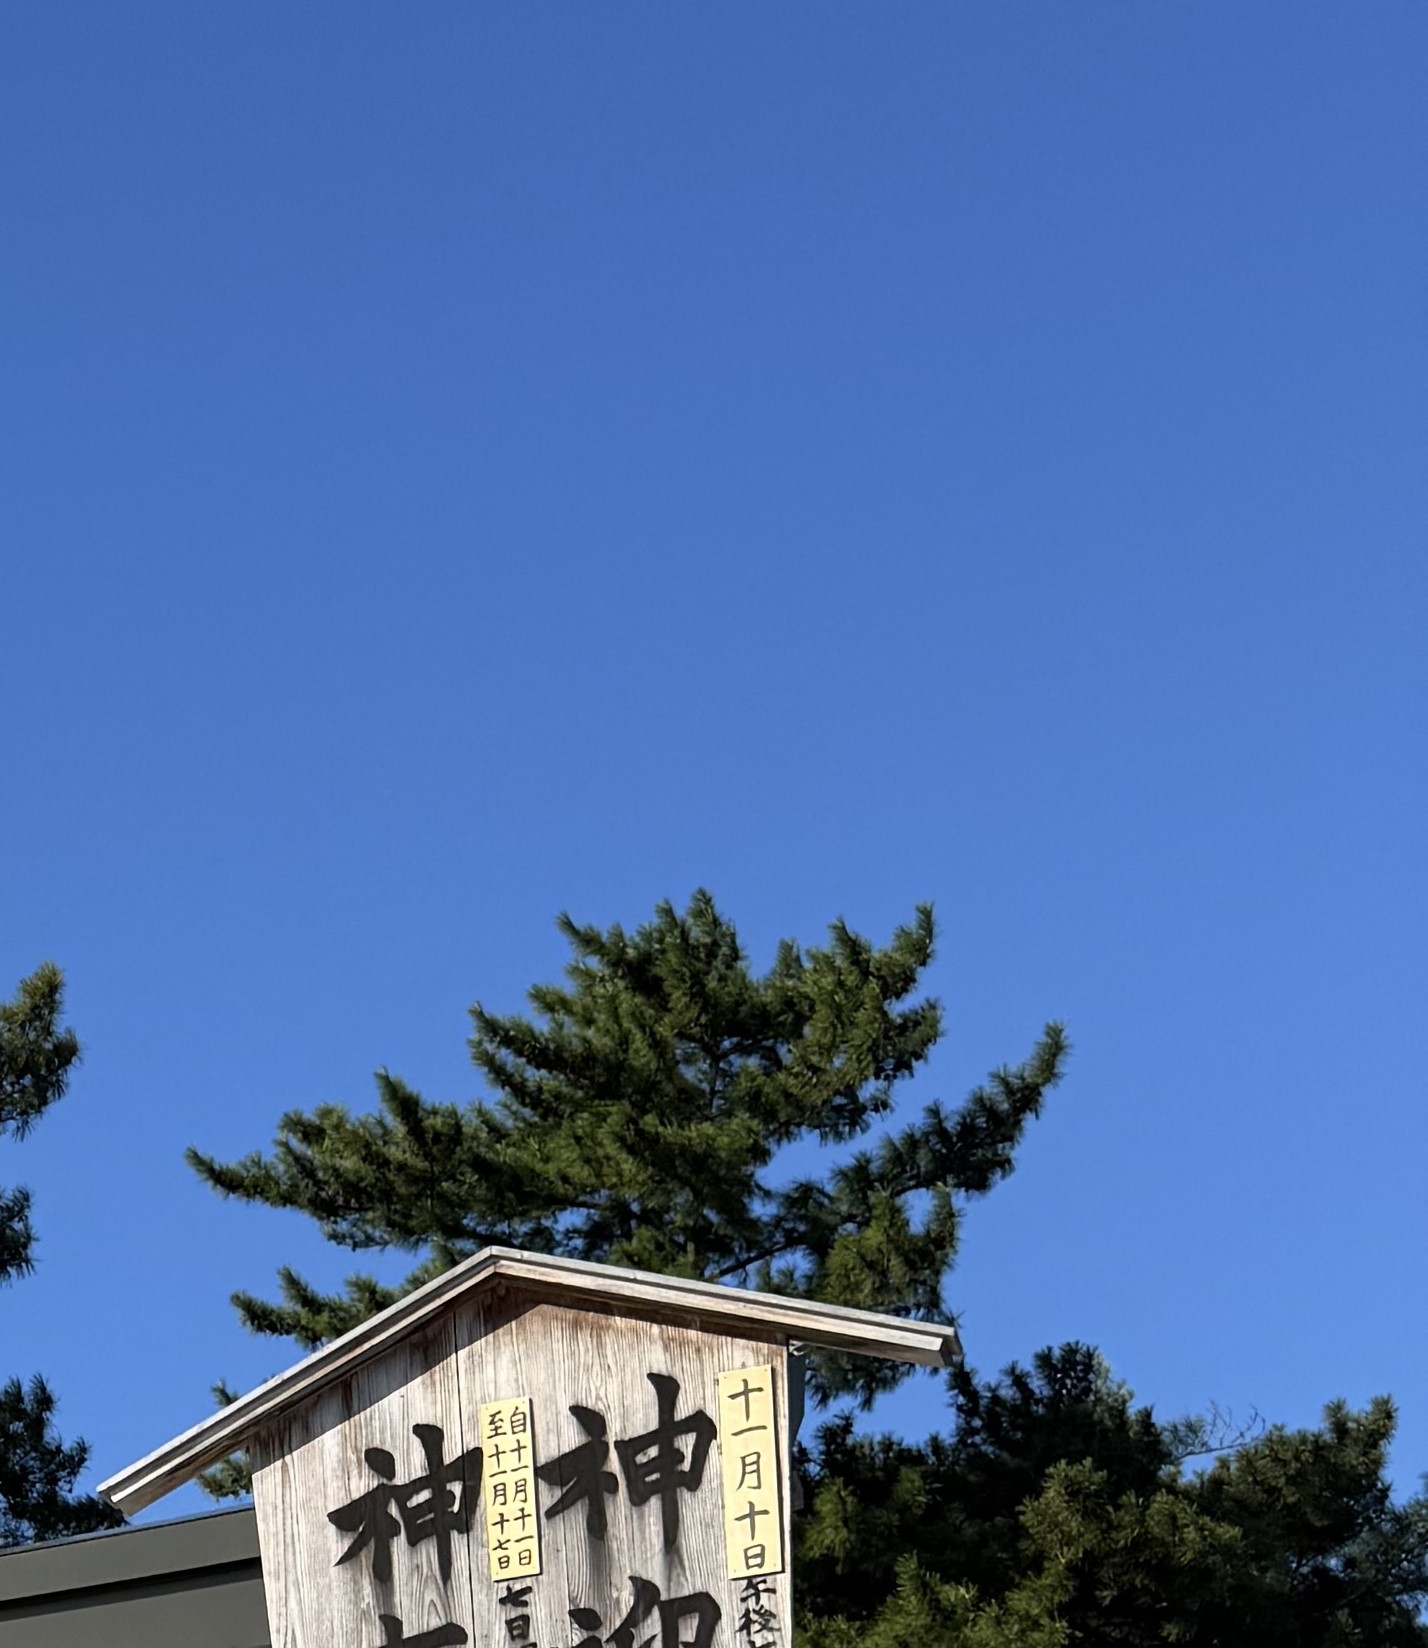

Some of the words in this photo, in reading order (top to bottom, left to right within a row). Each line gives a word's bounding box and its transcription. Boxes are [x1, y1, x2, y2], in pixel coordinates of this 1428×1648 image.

[487, 1410, 511, 1569] 至十一月十七日
[727, 1378, 770, 1569] 十一月十日
